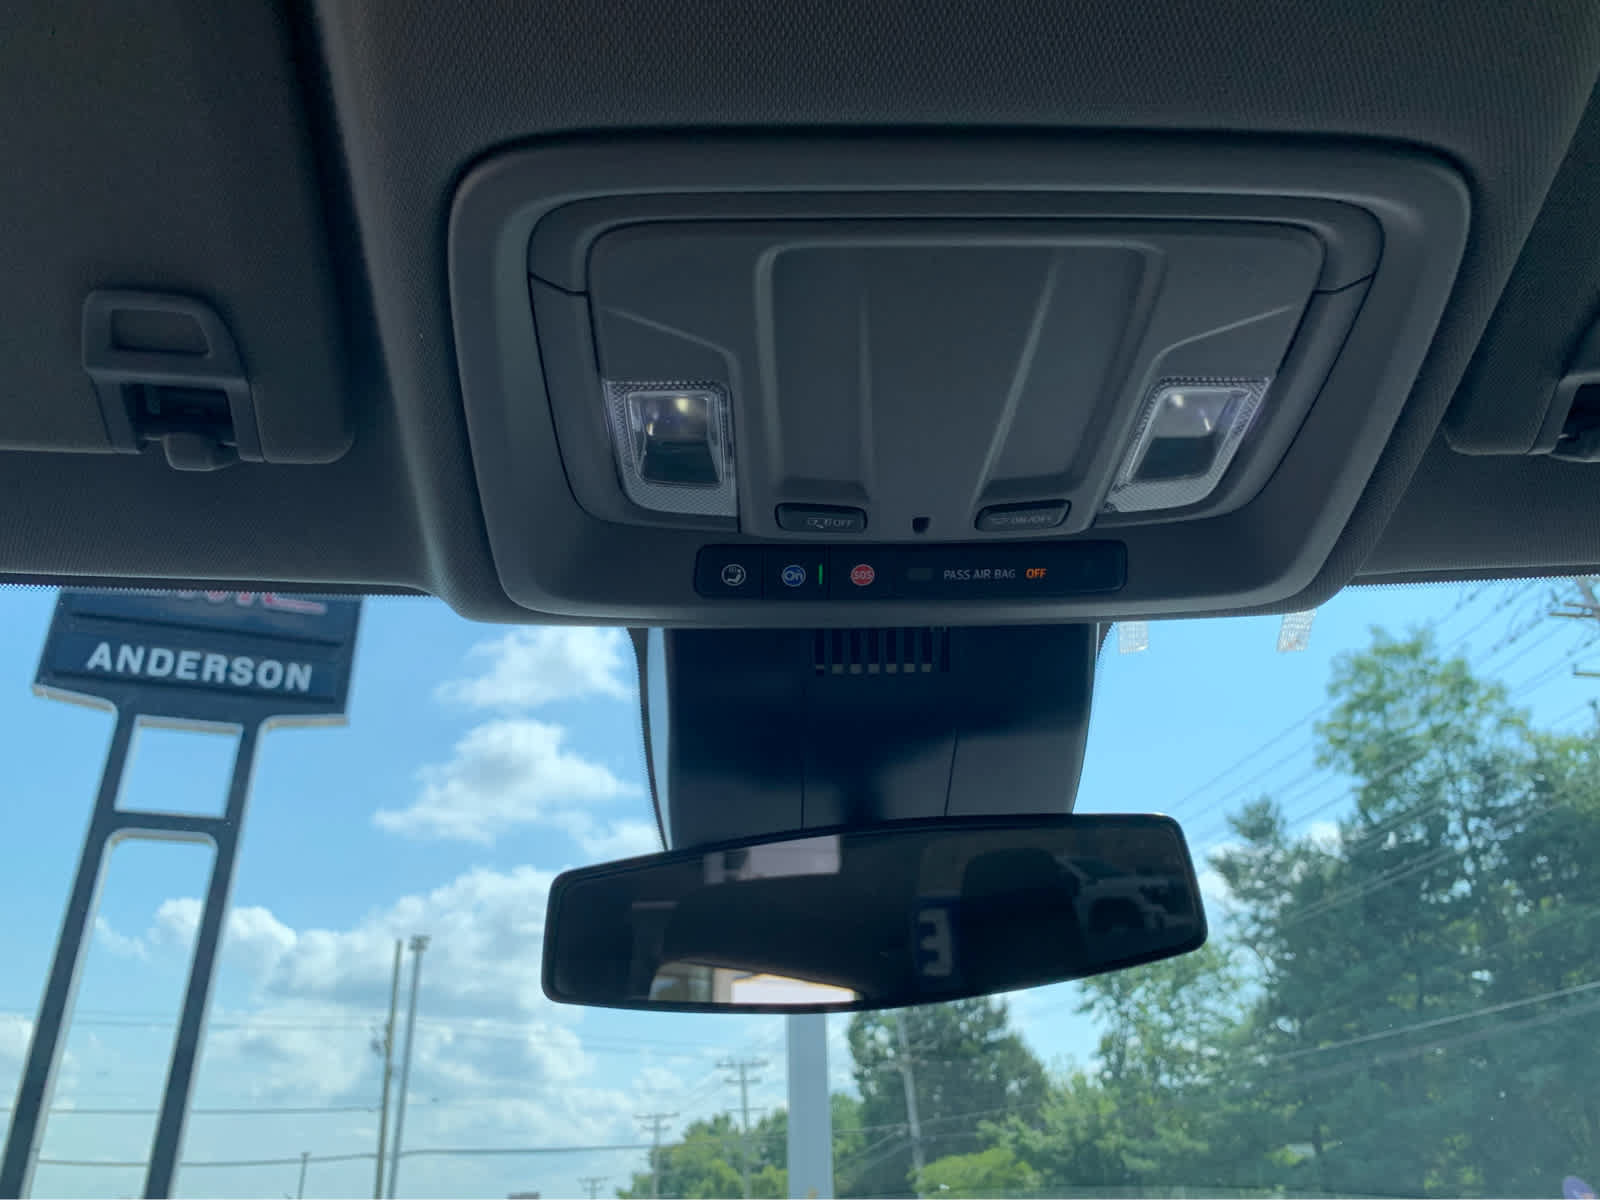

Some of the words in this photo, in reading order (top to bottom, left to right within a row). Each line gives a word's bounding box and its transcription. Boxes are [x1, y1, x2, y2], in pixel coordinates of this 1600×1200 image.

[943, 568, 971, 581] PASS
[973, 568, 992, 580] AIR
[994, 568, 1016, 580] BAG
[1025, 568, 1047, 579] OFF
[86, 641, 313, 692] ANDERSON
